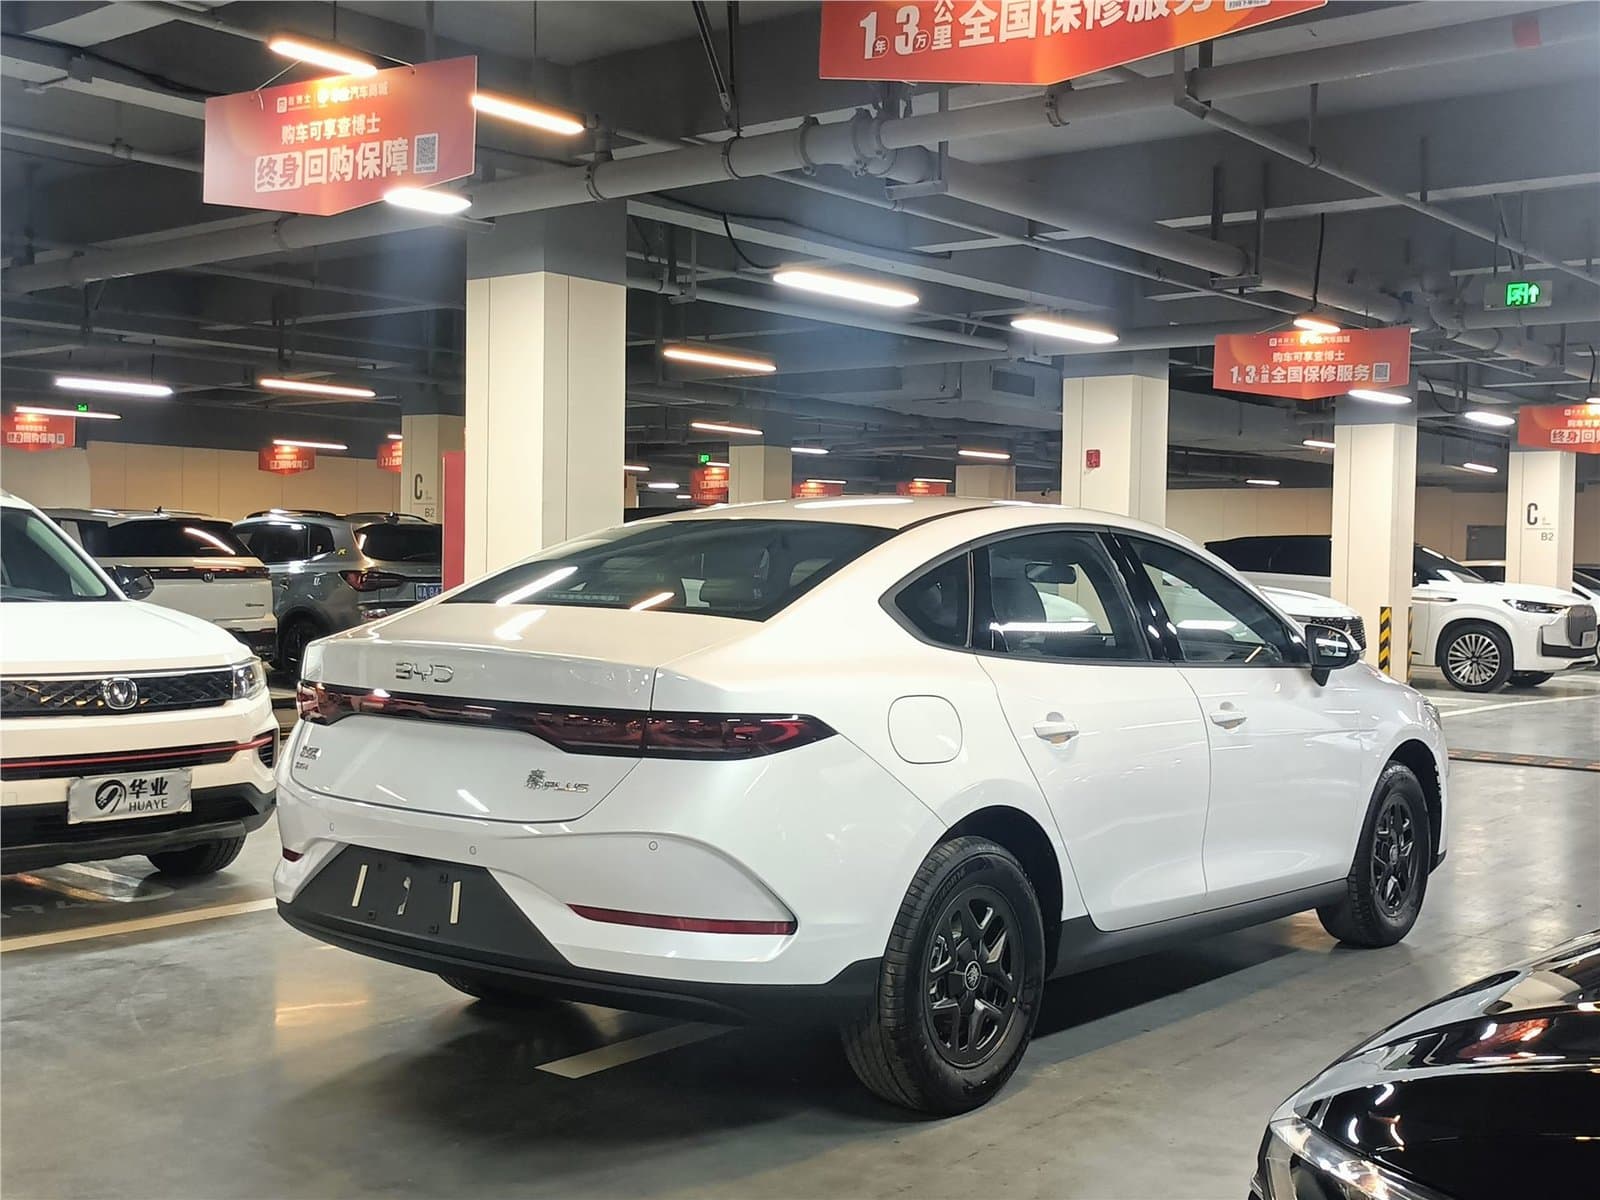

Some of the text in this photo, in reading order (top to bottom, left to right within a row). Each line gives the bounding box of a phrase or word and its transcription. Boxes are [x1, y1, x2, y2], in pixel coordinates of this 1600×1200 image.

[281, 112, 381, 145] 购车可享查博士
[256, 137, 409, 190] 终身回购保障
[1551, 429, 1600, 444] 终身回
[414, 473, 423, 500] C
[1527, 502, 1538, 525] C
[1541, 532, 1554, 541] B2
[395, 662, 454, 683] BYD
[128, 777, 168, 799] 华业
[128, 798, 168, 812] HUAYE
